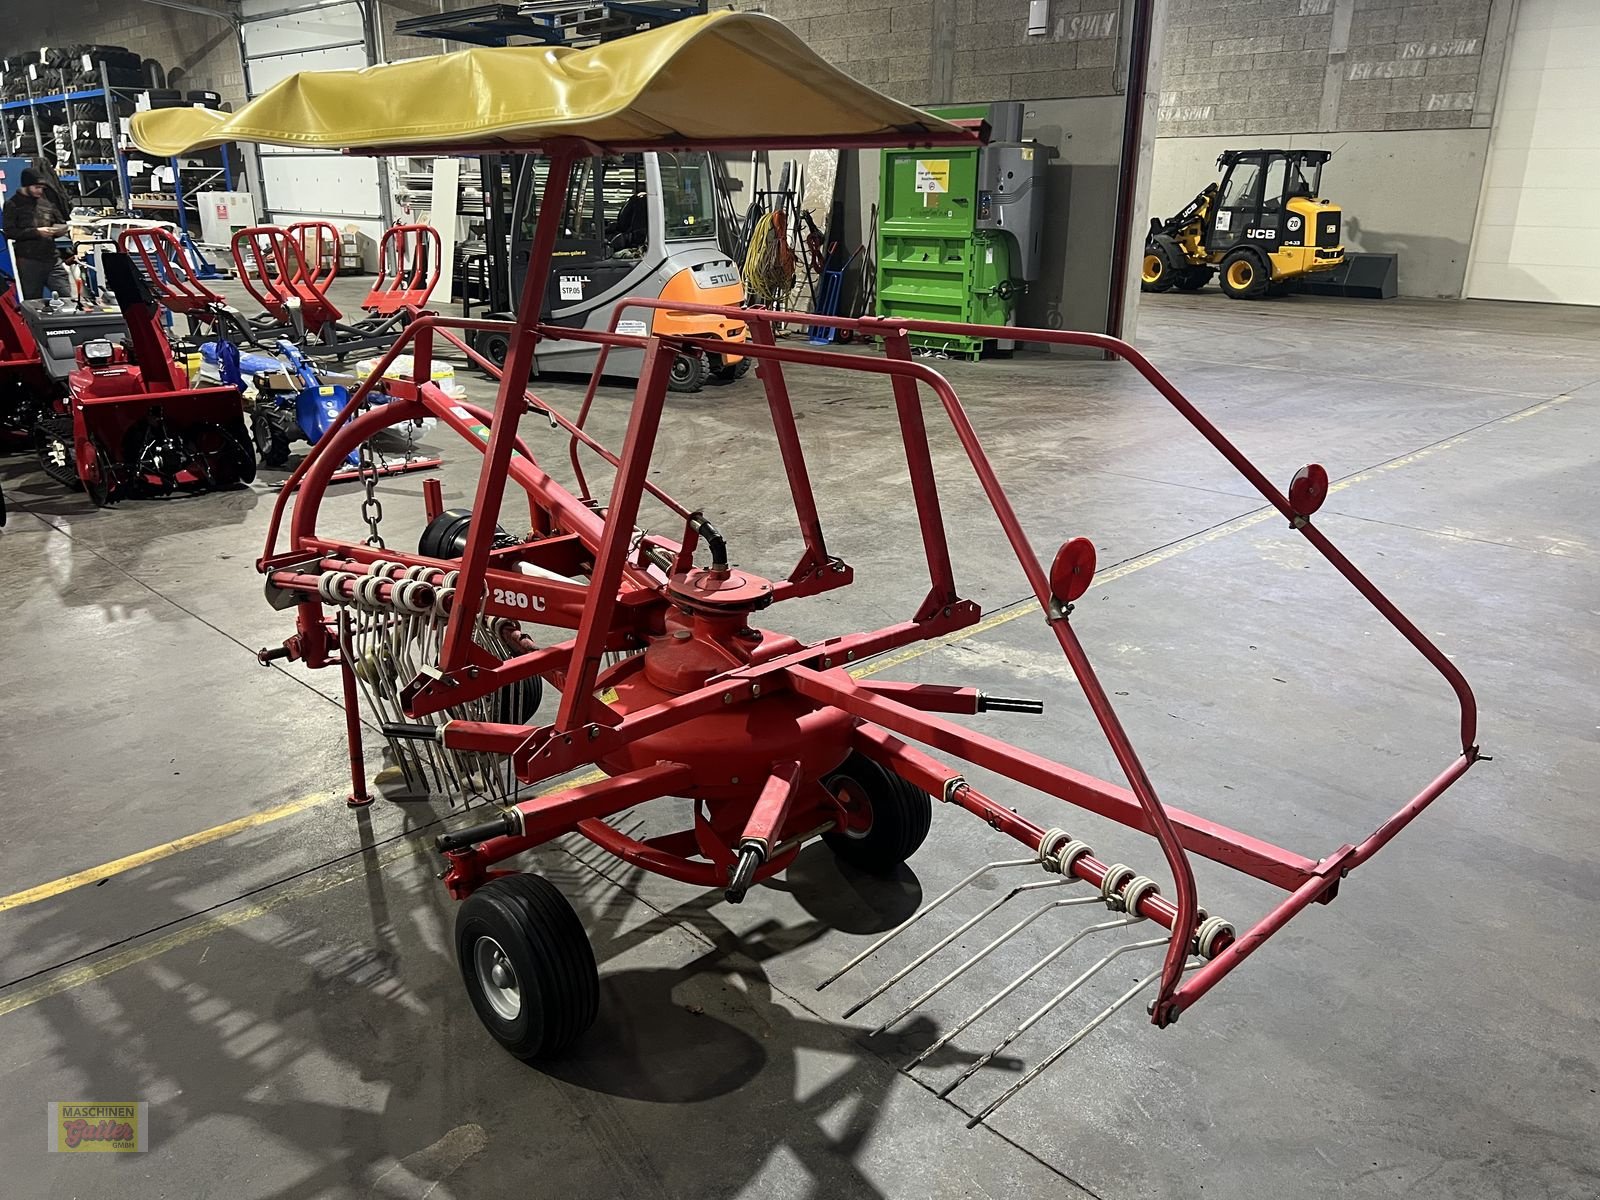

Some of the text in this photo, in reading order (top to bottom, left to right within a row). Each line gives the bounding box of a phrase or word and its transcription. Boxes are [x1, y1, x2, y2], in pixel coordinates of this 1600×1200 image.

[1182, 202, 1198, 218] JCB
[1289, 219, 1299, 228] 20
[1246, 229, 1276, 239] JCB
[709, 273, 737, 285] STILL
[493, 588, 529, 609] 280
